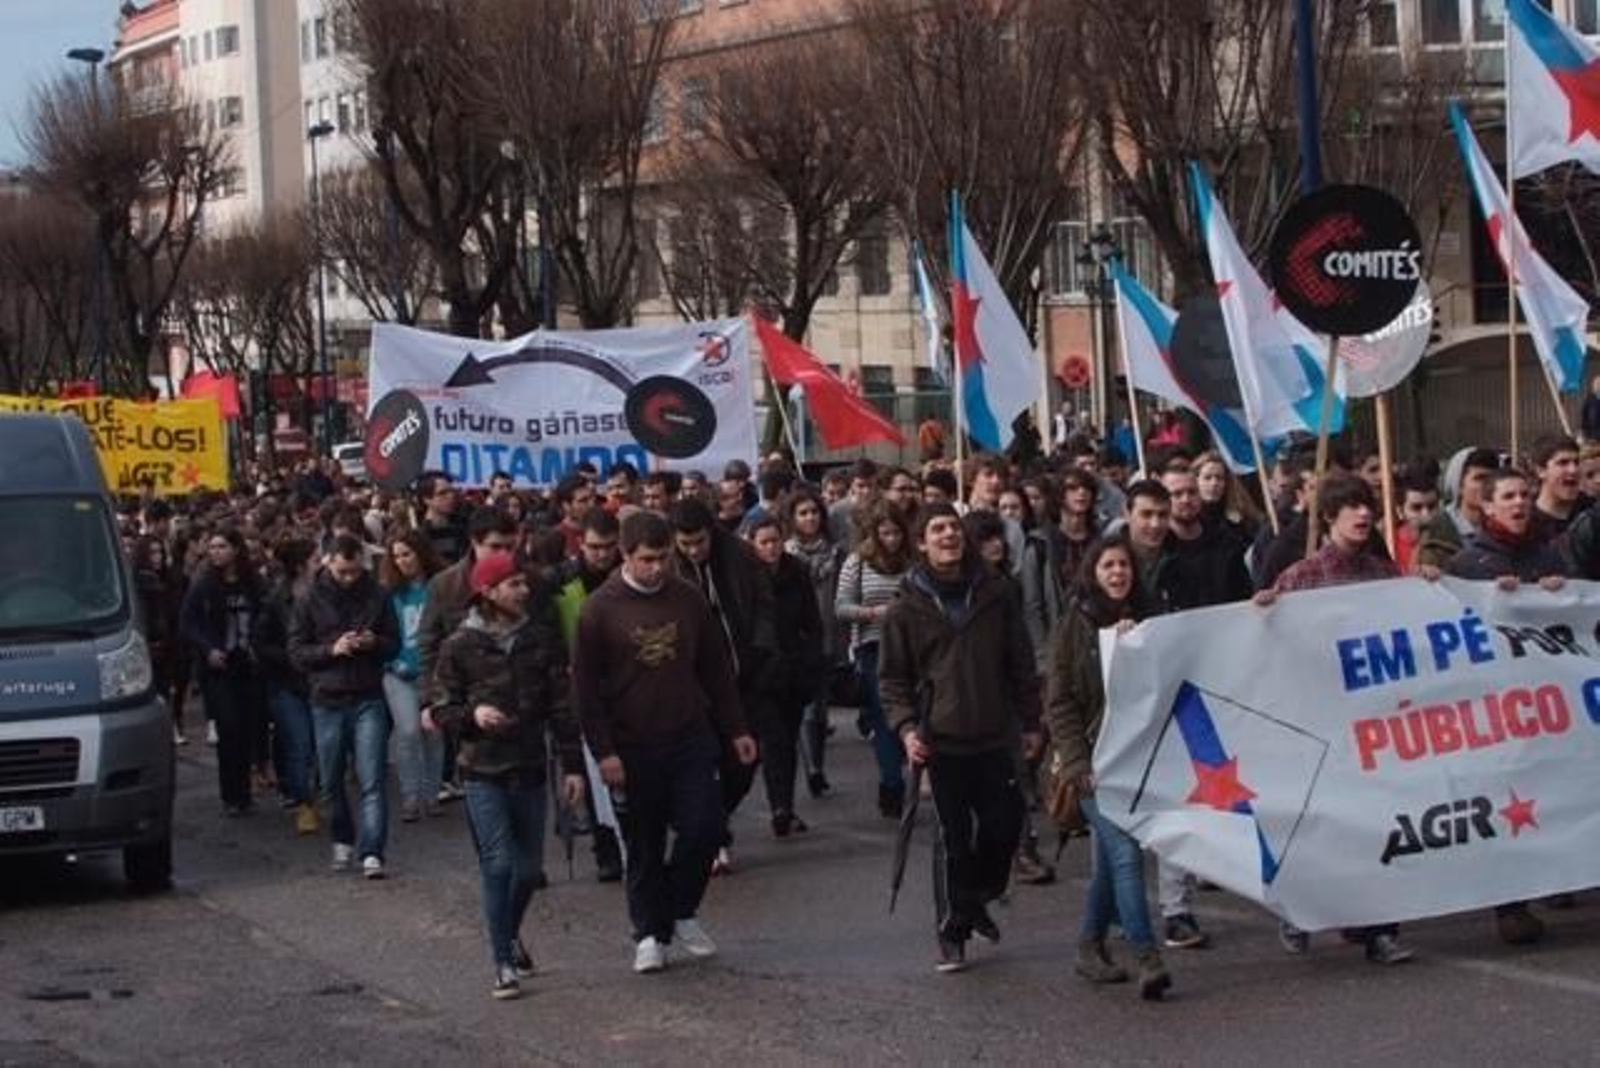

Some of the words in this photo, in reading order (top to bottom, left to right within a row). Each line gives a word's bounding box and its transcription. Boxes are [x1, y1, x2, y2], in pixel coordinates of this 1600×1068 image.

[1323, 239, 1421, 281] COMITÉS
[434, 405, 515, 434] futuro
[1336, 627, 1418, 692] EM
[1425, 606, 1496, 672] PÉ
[1352, 683, 1572, 771] PÚBLICO
